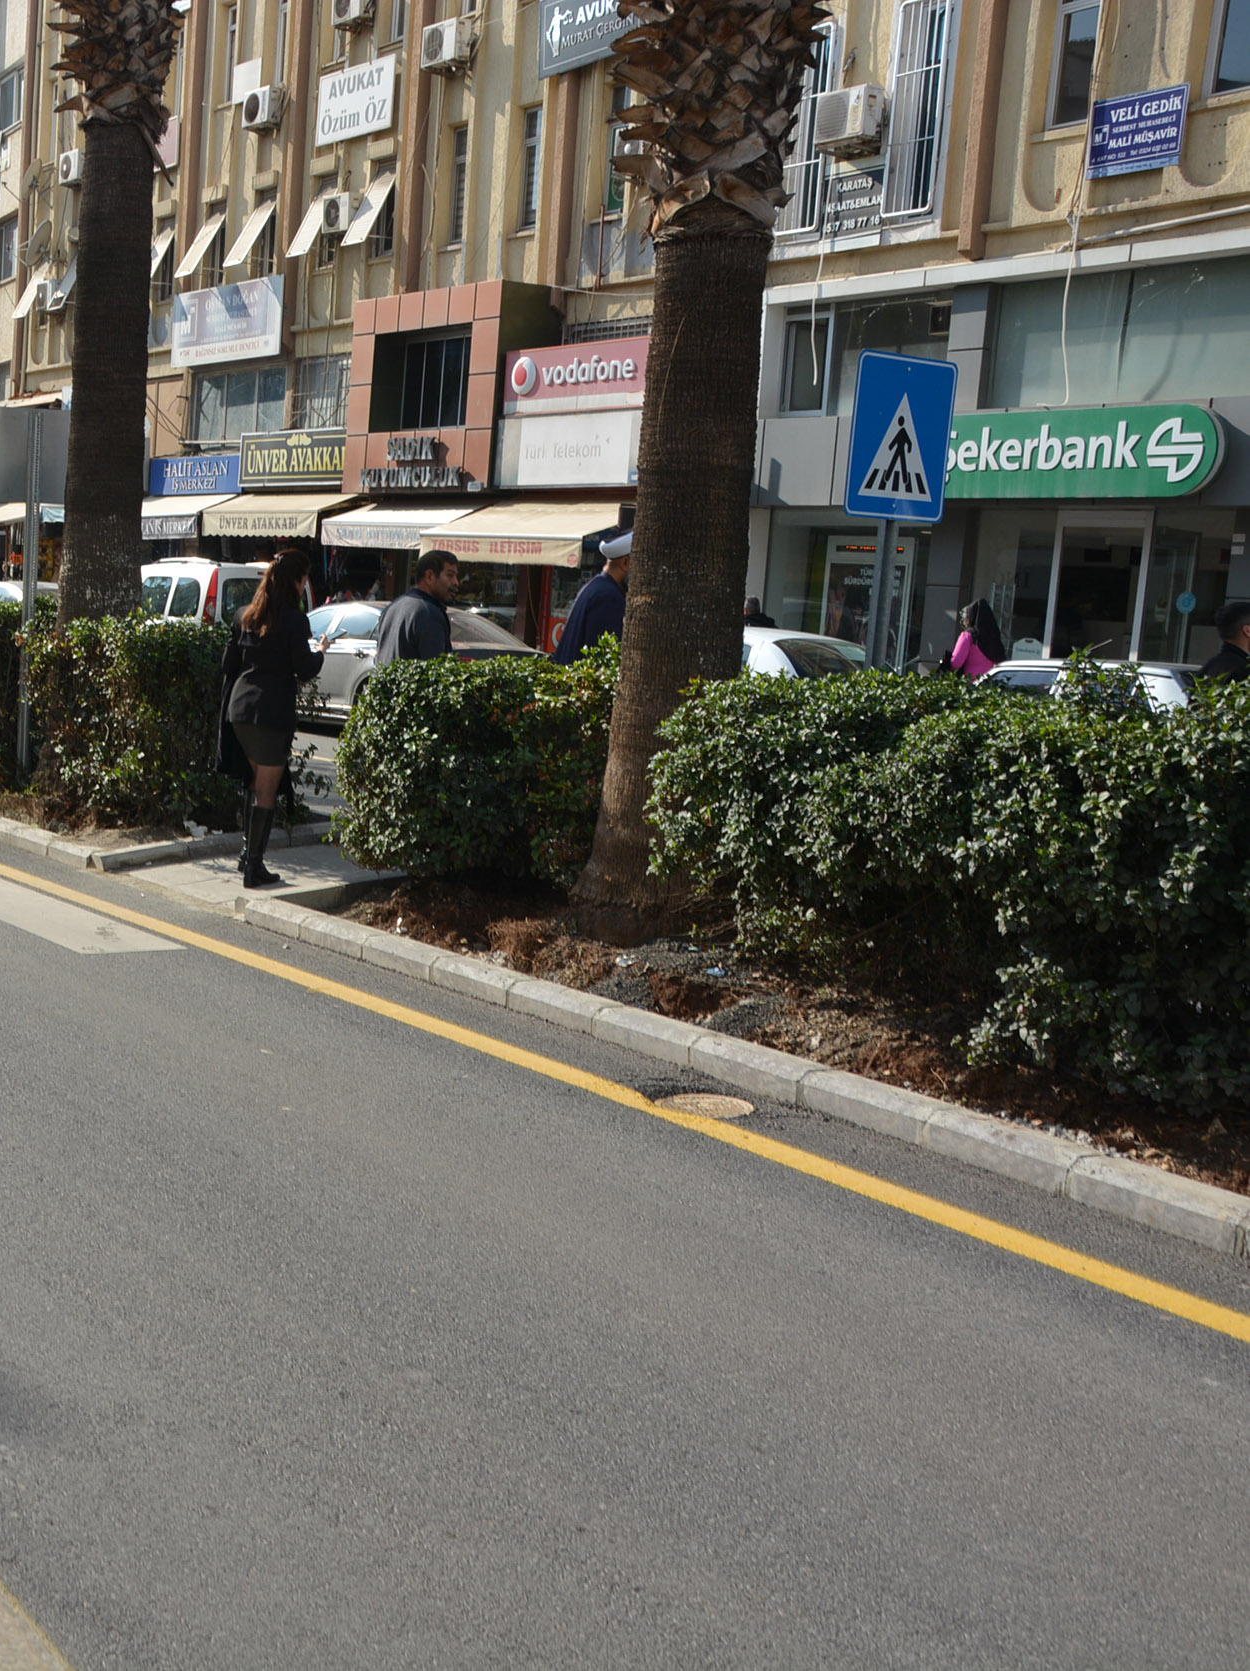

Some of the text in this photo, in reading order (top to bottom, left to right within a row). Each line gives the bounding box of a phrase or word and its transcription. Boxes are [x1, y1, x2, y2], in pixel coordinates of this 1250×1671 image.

[575, 0, 620, 25] AVUK
[561, 27, 595, 49] MURAT
[329, 66, 384, 100] AVUKAT
[321, 95, 387, 136] Özüm ÖZ
[1111, 94, 1182, 123] VELİ GEDİK
[1108, 126, 1177, 150] MALİ MÜŞAVİR
[1112, 121, 1137, 134] SERBEST
[837, 176, 873, 193] KARATAŞ
[826, 193, 883, 215] NŞAAT&EMLAK
[843, 218, 856, 231] 318
[857, 216, 869, 228] 77
[870, 215, 880, 226] 16
[542, 354, 637, 386] vodafone
[247, 444, 346, 474] ÜNVER AYAKKA
[386, 436, 436, 462] SADIK
[552, 441, 602, 459] Telekom
[163, 459, 229, 477] HALİT ASLAN
[360, 465, 462, 489] KUYUMCULUK
[172, 475, 216, 493] İŞ MERKEZİ
[219, 514, 298, 531] ÜNVER AYAKKABI
[431, 539, 543, 557] TARSUS İLETİŞİM
